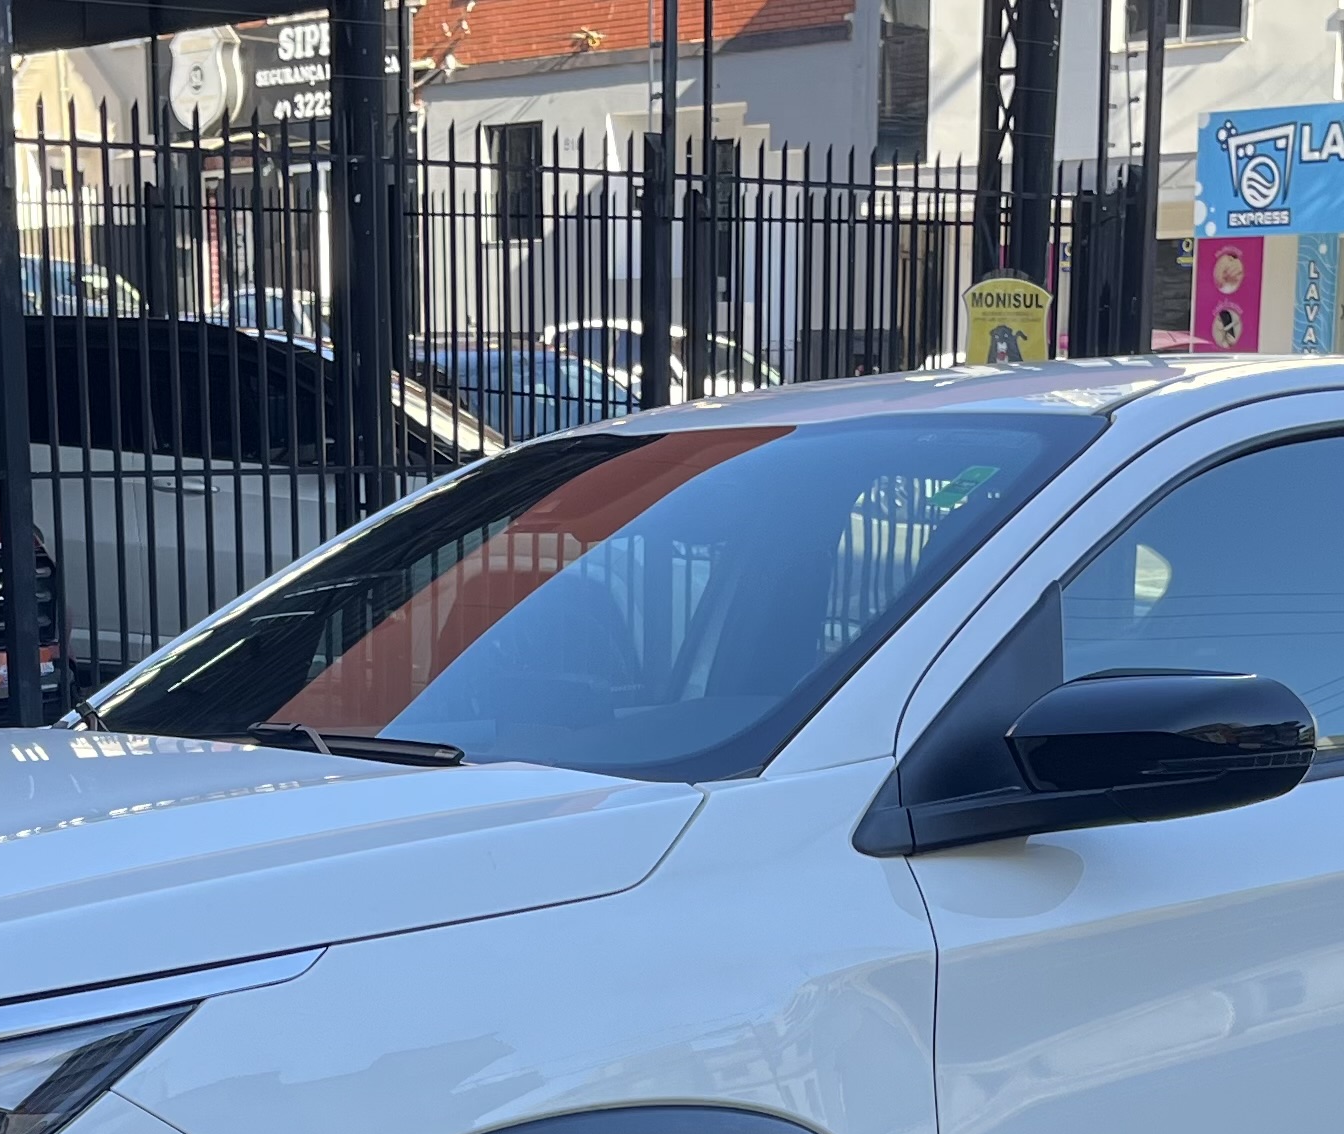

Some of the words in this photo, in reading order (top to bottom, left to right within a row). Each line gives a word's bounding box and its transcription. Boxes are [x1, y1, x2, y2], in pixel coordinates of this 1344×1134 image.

[1229, 209, 1289, 227] EXPRESS
[971, 292, 1043, 309] MONISUL
[1302, 259, 1321, 354] LAVA
